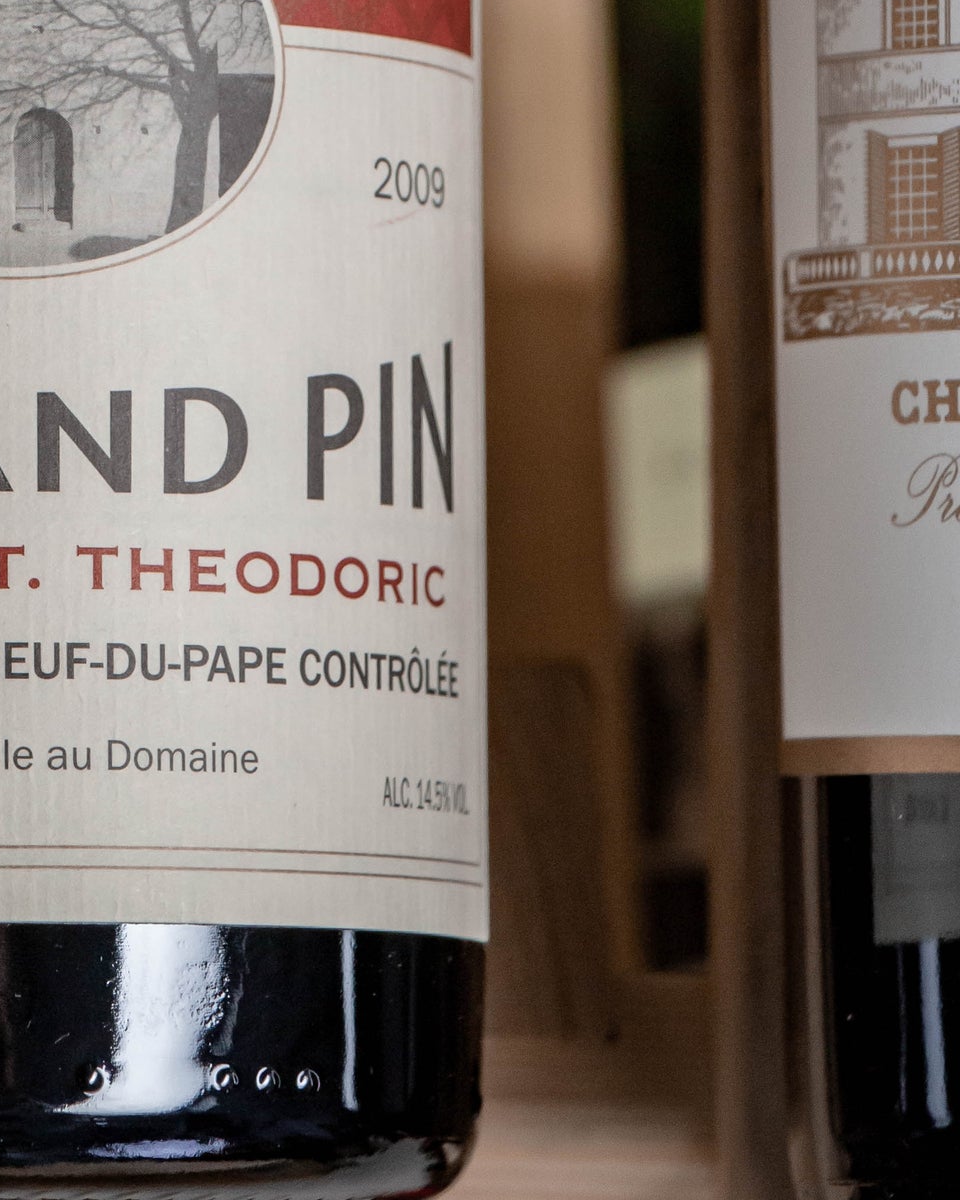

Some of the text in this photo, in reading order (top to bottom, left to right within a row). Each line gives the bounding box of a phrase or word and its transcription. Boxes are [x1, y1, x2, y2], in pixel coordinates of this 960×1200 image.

[373, 156, 445, 208] 2009
[306, 339, 455, 515] PIN
[76, 544, 447, 609] THEODORIC
[299, 645, 460, 699] CONTRÔLÉE
[46, 741, 93, 772] au
[107, 738, 260, 775] Domaine
[382, 775, 414, 810] ALC.
